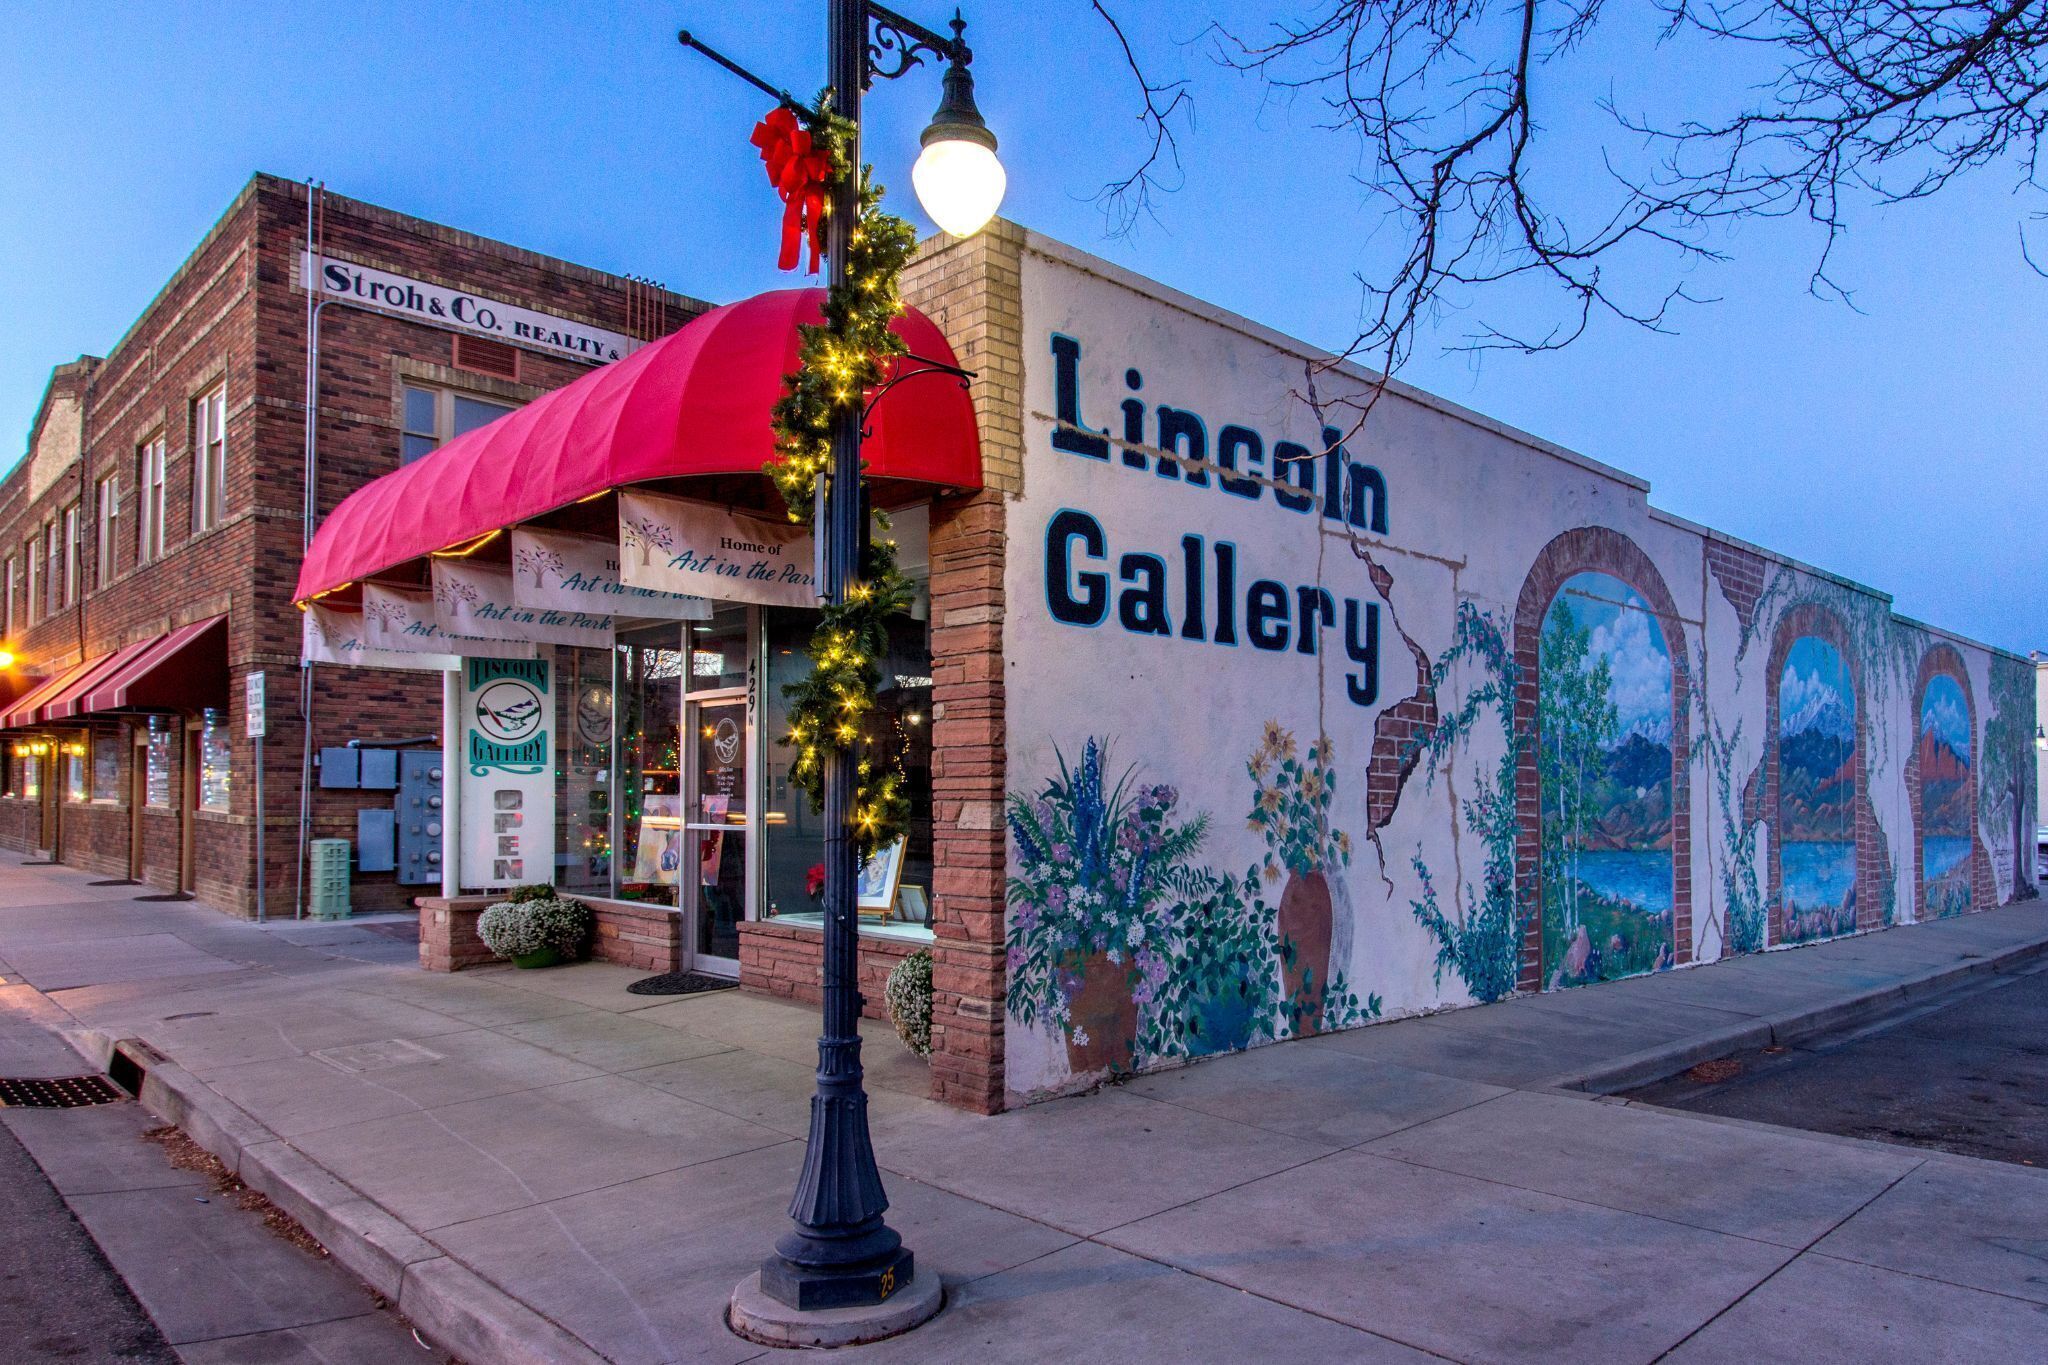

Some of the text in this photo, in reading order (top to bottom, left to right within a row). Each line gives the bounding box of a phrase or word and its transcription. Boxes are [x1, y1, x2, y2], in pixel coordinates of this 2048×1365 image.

[324, 264, 621, 361] Stroh & Co. REALTY &
[1050, 332, 1390, 535] Lincoln
[720, 537, 783, 556] Home of
[667, 550, 716, 574] Art
[716, 558, 741, 578] in
[746, 561, 777, 582] the
[560, 572, 601, 593] Art
[602, 578, 625, 595] in
[474, 602, 613, 631] Art in the Park
[1044, 507, 1381, 708] Gallery
[402, 620, 437, 637] Art
[473, 660, 545, 687] LINCOLN
[748, 658, 756, 713] 429
[473, 735, 544, 762] GALLERY
[494, 789, 523, 880] OPEN
[881, 1266, 895, 1298] 25
